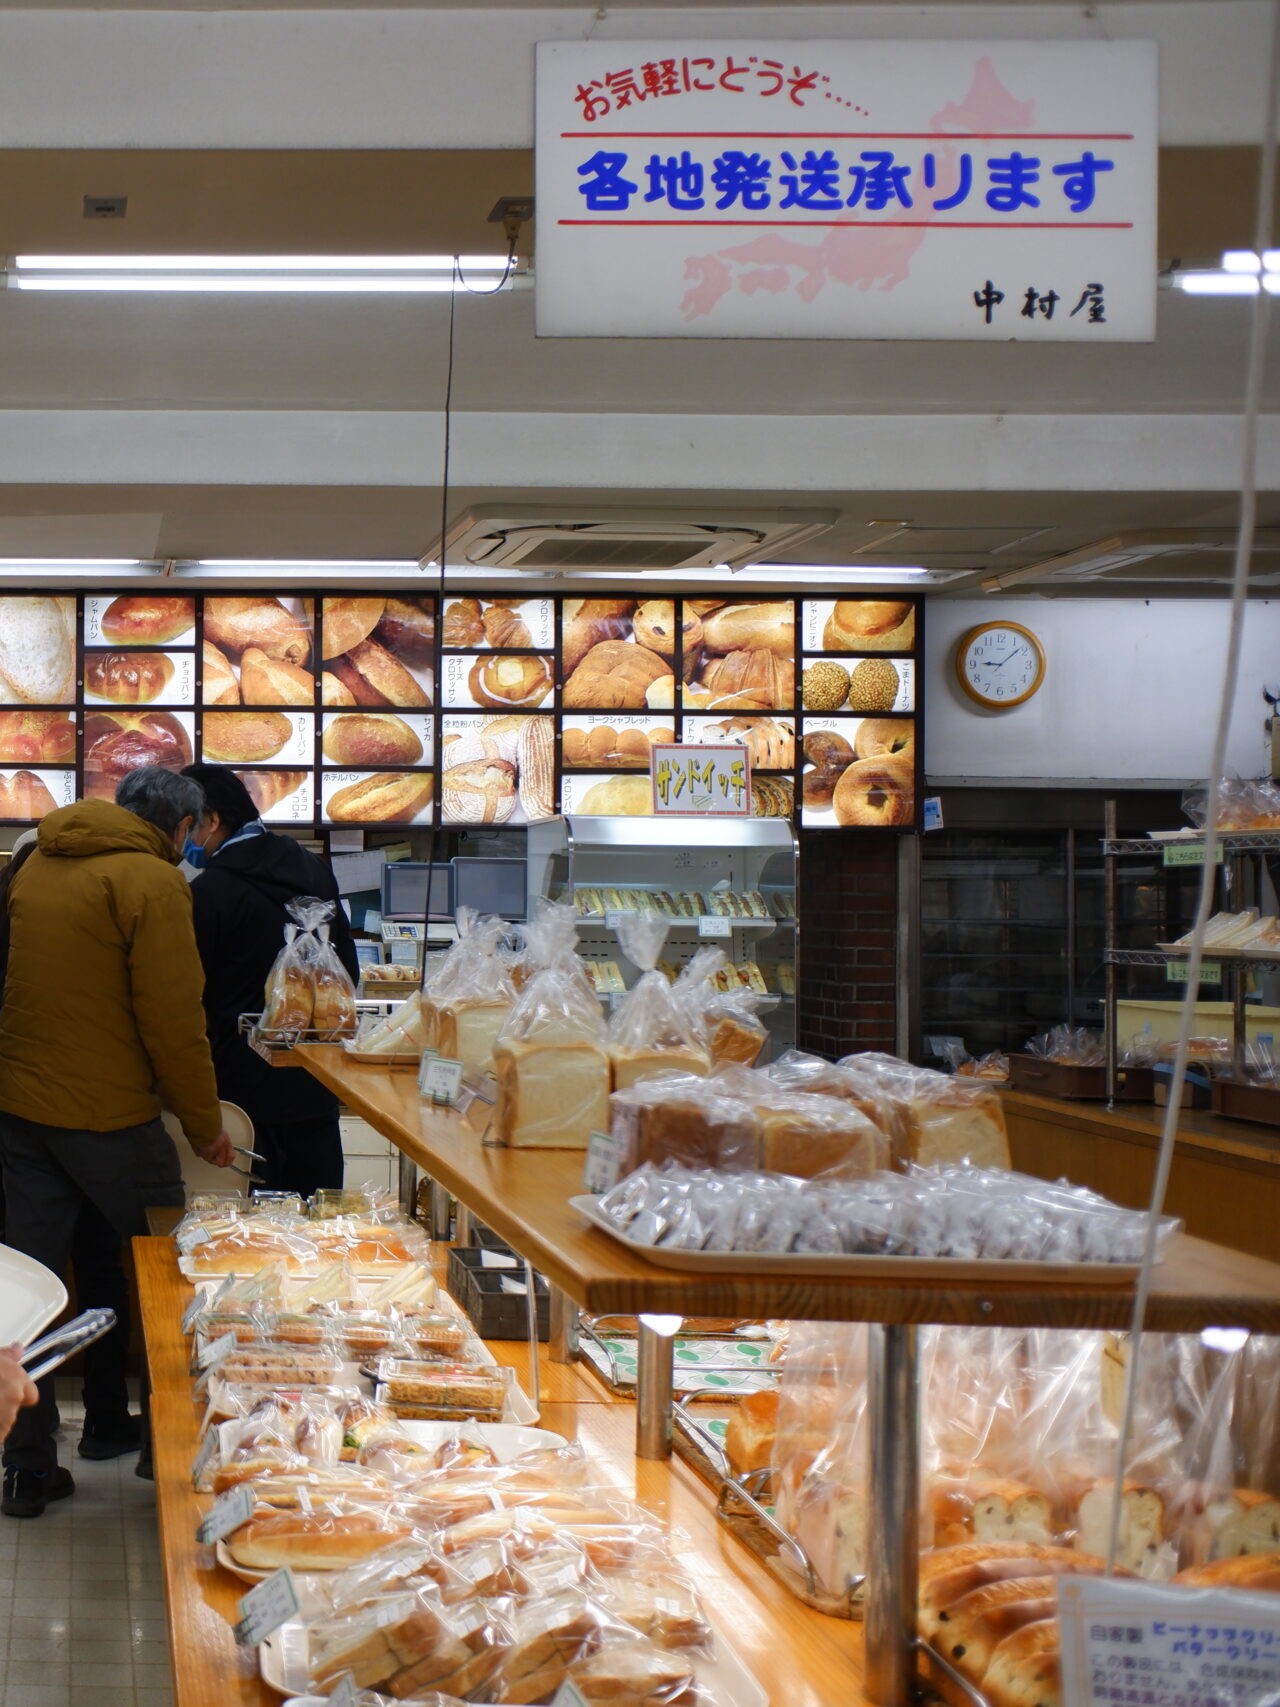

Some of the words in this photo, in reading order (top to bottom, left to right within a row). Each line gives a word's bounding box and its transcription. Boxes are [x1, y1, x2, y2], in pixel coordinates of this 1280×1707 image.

[576, 150, 1114, 212] 各地発送承ります
[974, 280, 1108, 324] 中村屋
[90, 599, 98, 640] ジャムパン
[540, 600, 548, 645] クロワッサン
[181, 660, 189, 700] チョコパン
[448, 658, 456, 704] クロワッサン
[297, 717, 306, 756] カレーパン
[63, 770, 72, 806] ぶどうパ
[323, 773, 360, 782] ホテルパン
[656, 759, 746, 808] サンドイッチ
[300, 788, 308, 811] チョコ
[1089, 1624, 1143, 1644] 自家製
